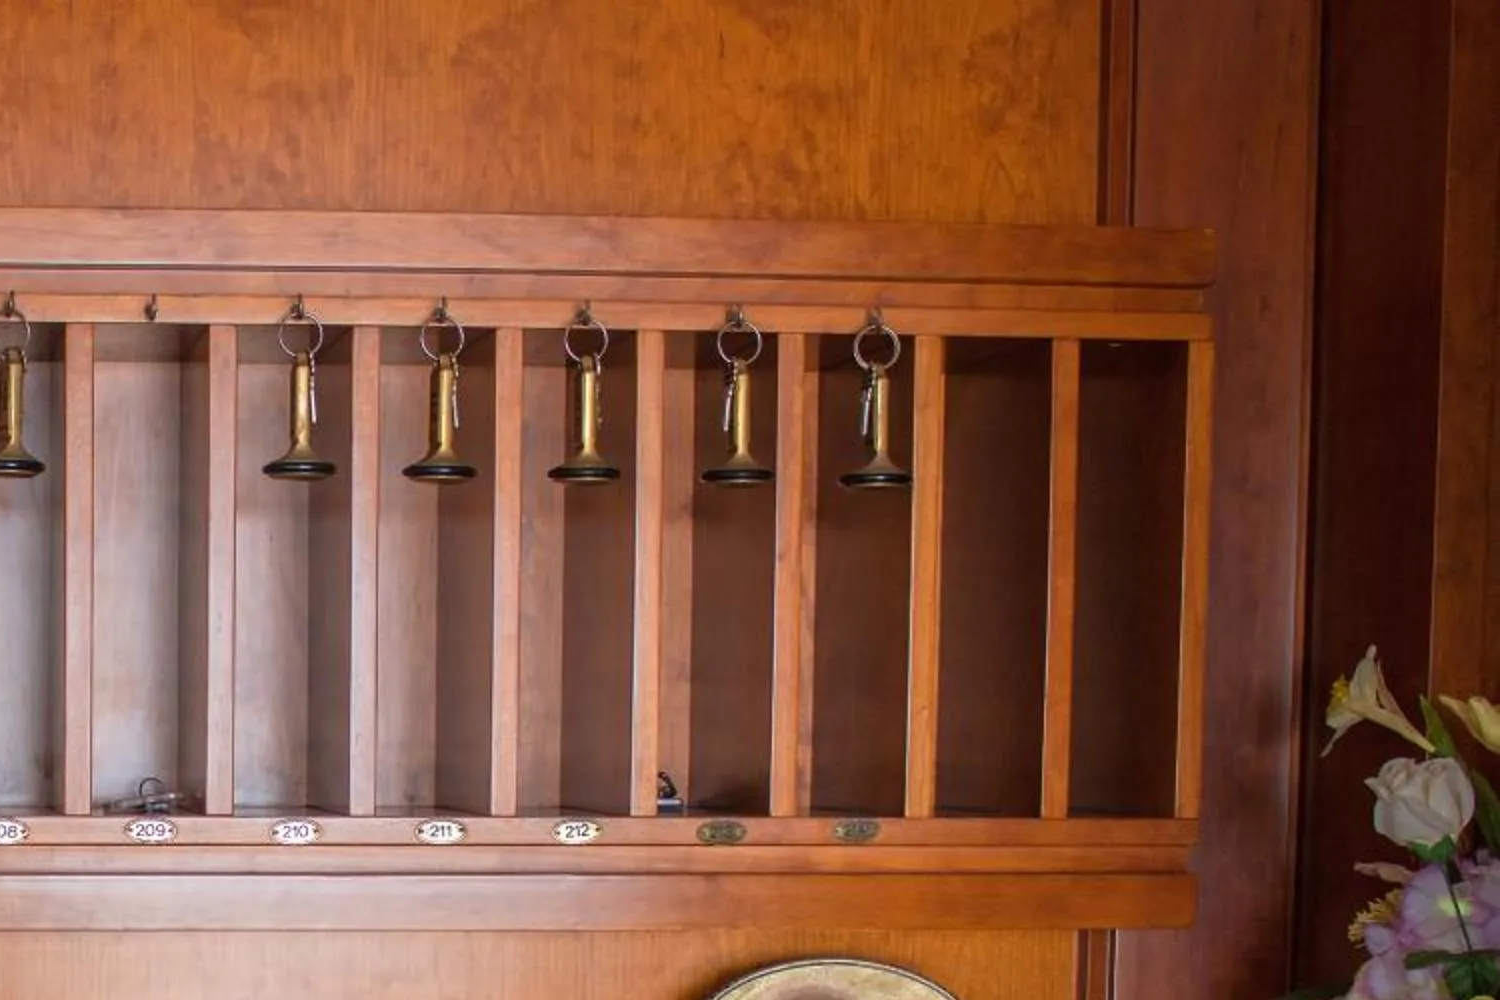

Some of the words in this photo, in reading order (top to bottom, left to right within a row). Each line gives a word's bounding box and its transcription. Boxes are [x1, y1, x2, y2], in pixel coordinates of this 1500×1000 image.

[136, 824, 165, 836] 209
[283, 825, 308, 838] 210
[430, 825, 453, 837] 211
[565, 824, 589, 838] 212
